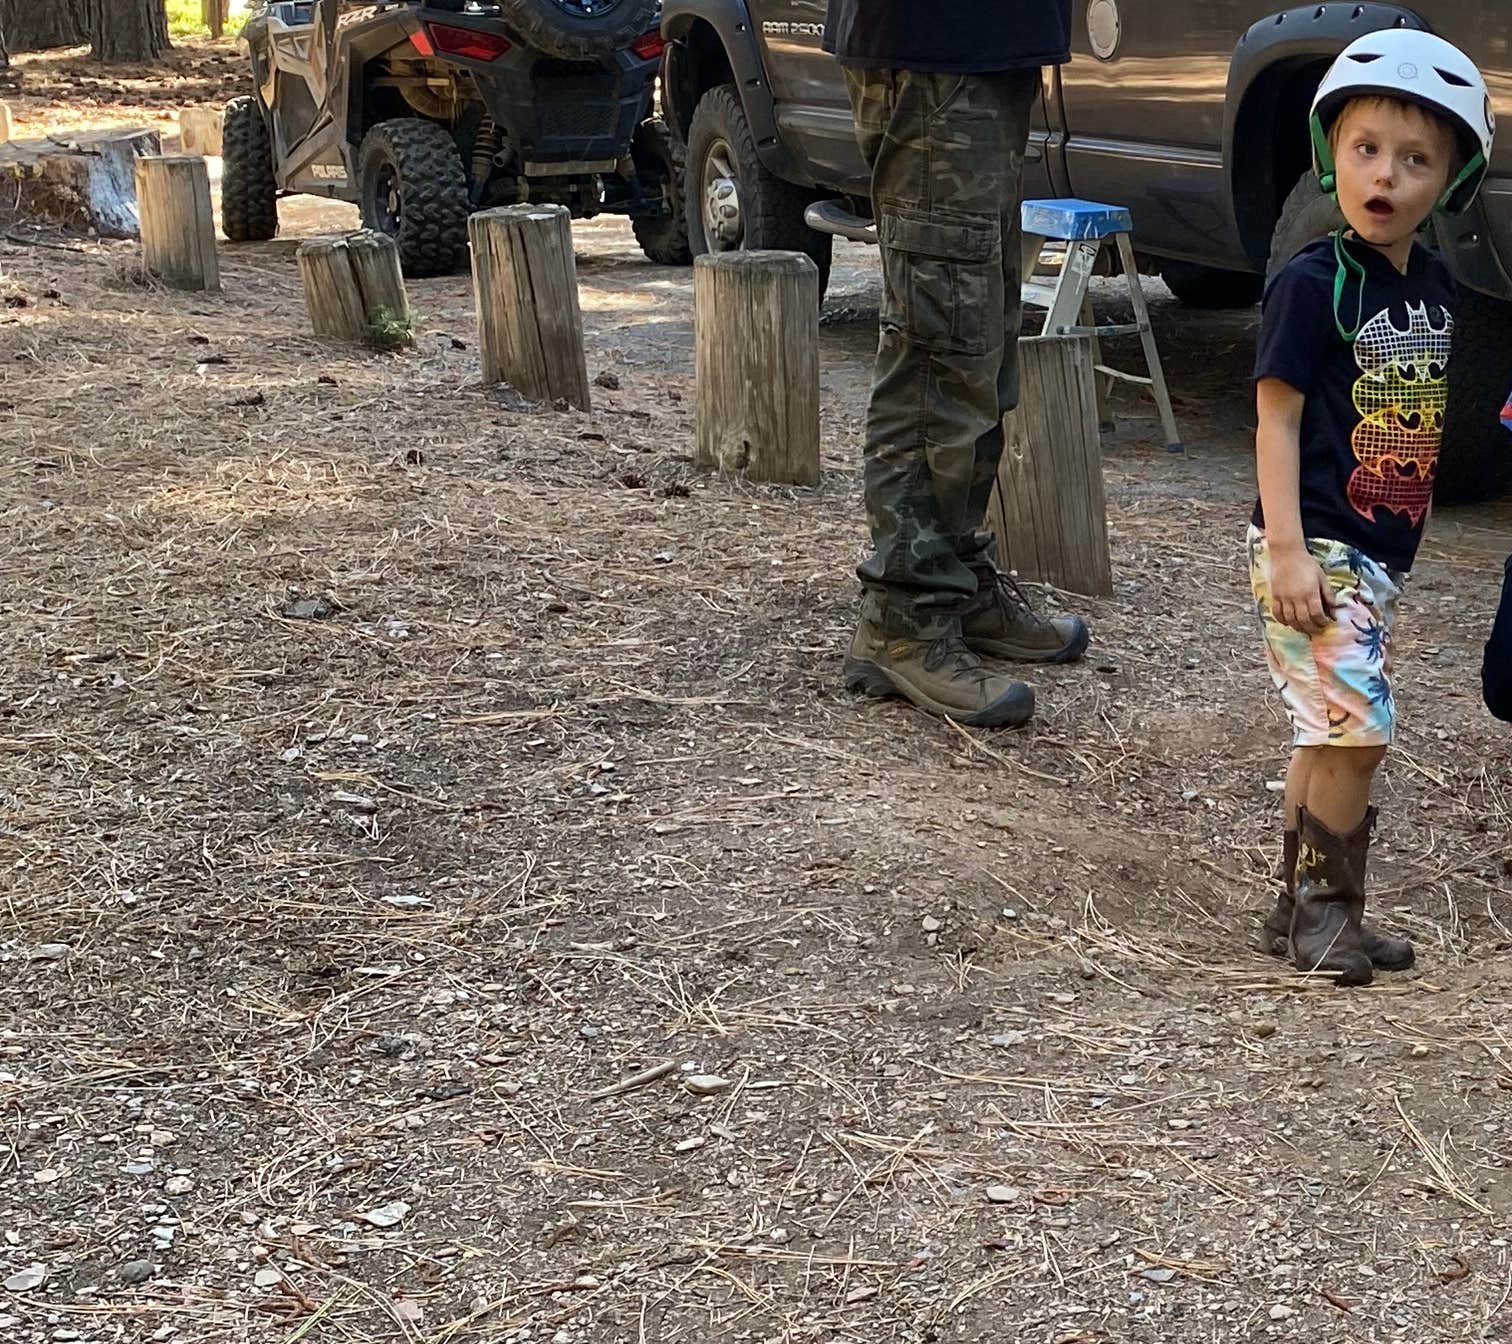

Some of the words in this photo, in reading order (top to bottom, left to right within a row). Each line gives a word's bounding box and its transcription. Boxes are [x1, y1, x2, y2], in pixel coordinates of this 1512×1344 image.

[336, 5, 377, 29] RZR
[762, 21, 790, 35] RAM
[790, 22, 825, 36] 2500
